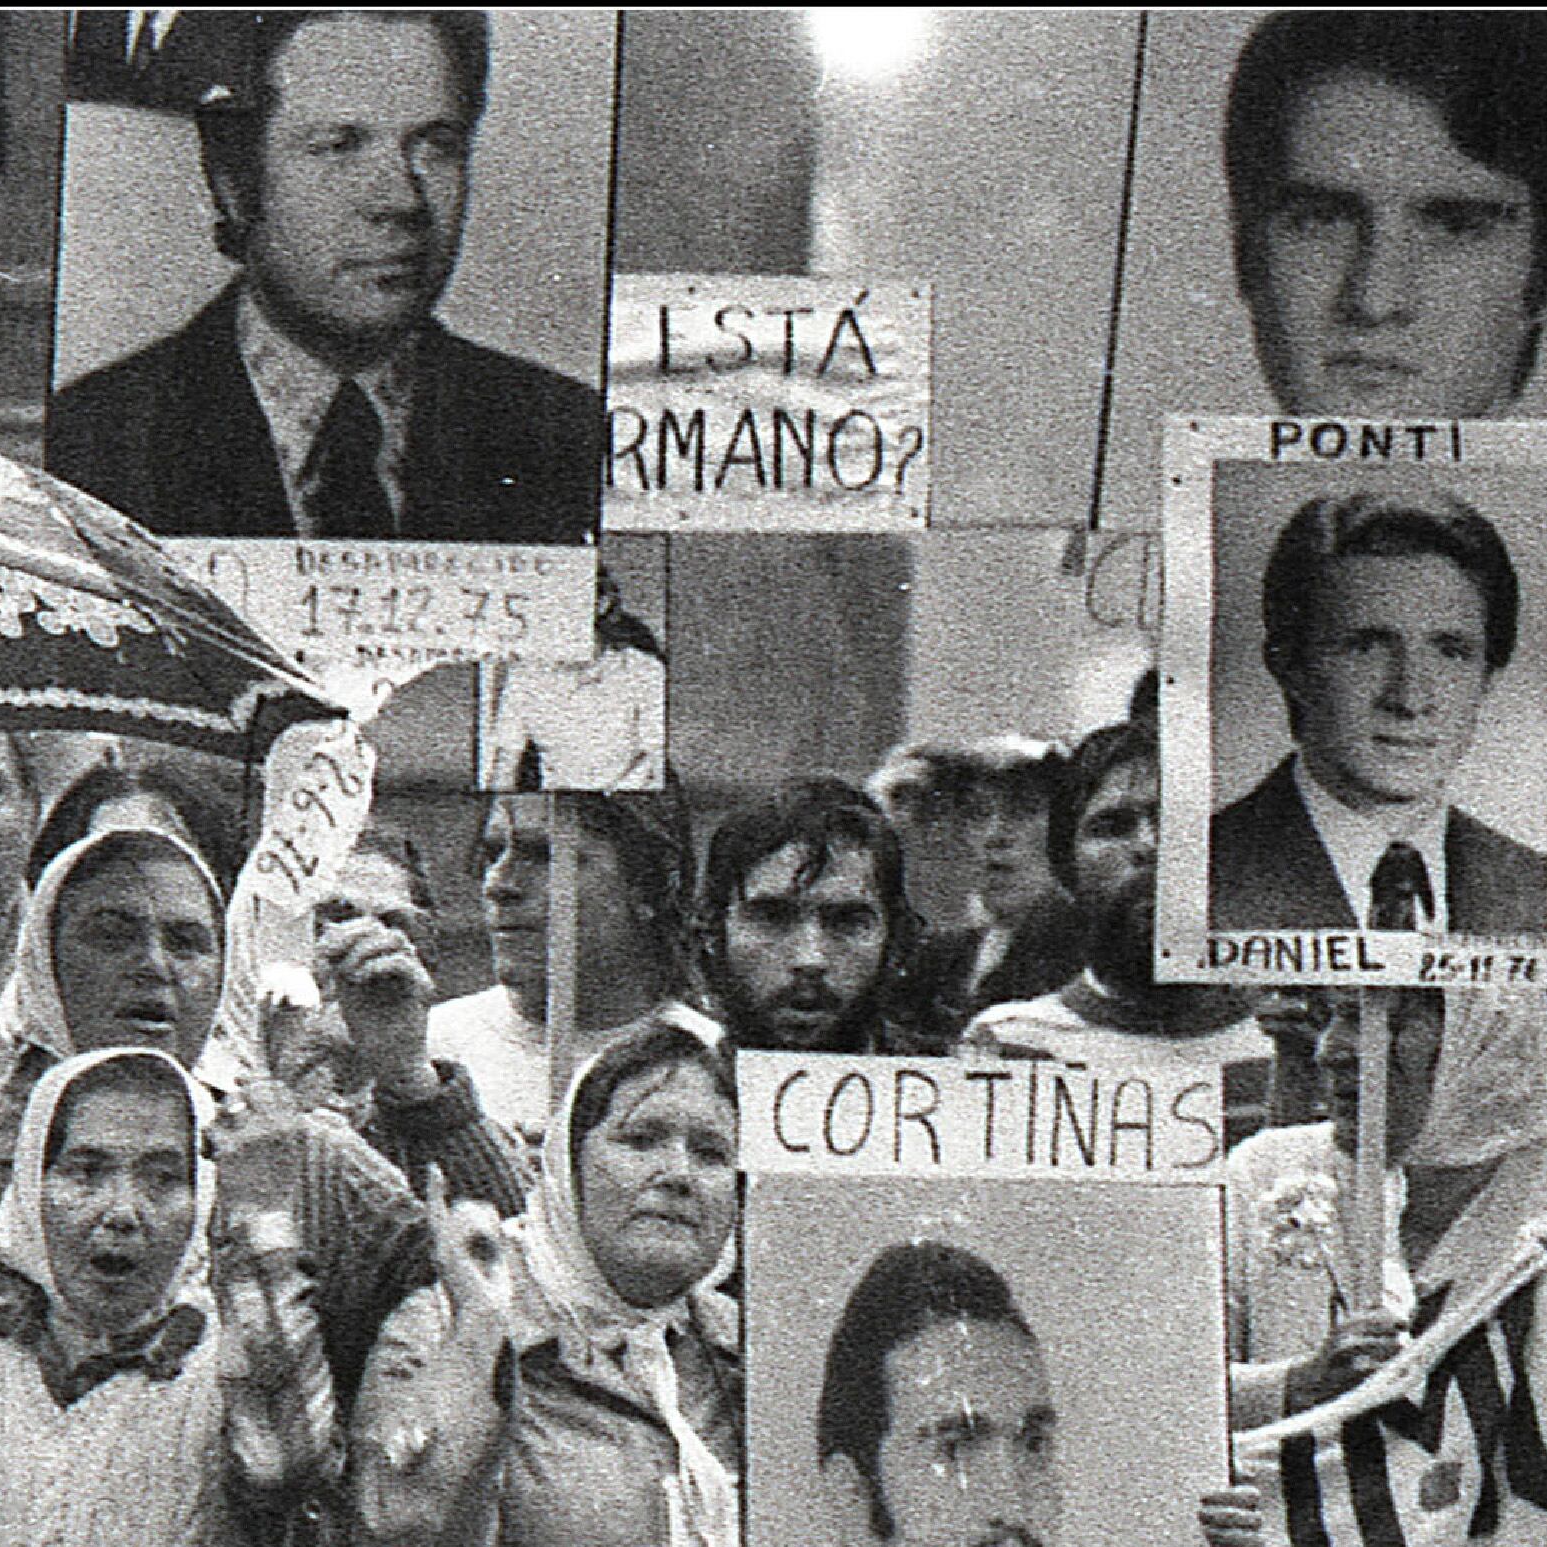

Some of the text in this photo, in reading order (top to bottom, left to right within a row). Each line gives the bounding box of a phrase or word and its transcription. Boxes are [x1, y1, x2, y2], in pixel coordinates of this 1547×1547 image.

[605, 407, 924, 495] RMANO?
[1270, 420, 1463, 462] PONTI
[1207, 935, 1386, 974] DANIEL
[772, 1061, 1221, 1172] CORTIÑAS
